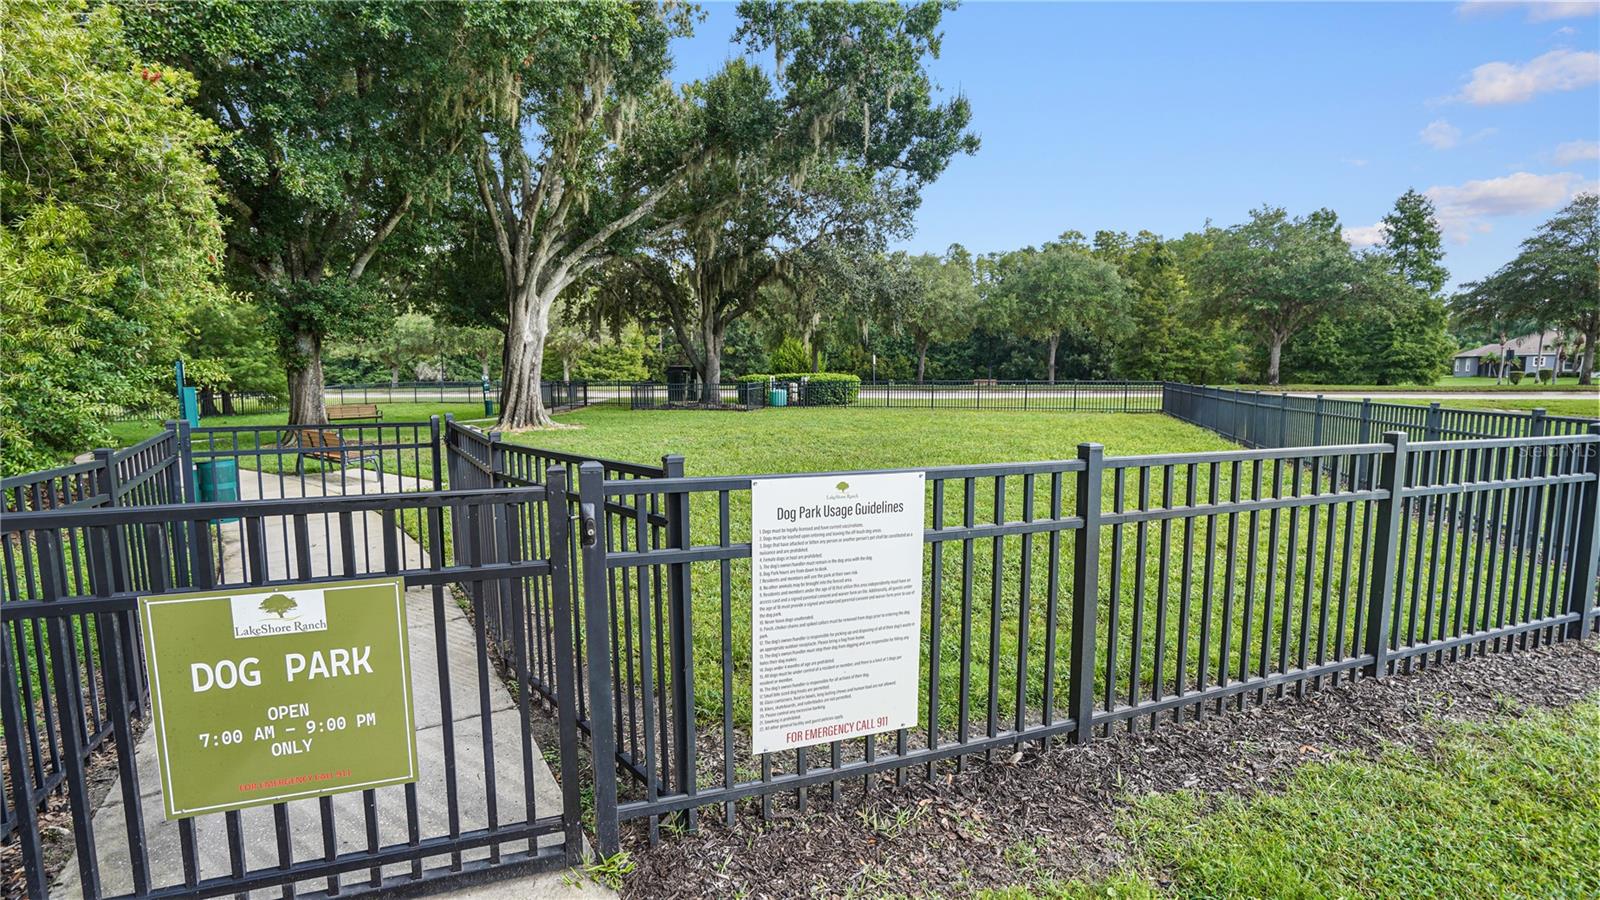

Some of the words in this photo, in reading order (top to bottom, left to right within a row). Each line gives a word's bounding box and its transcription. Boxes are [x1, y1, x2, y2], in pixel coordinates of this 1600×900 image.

[777, 507, 796, 523] Dog
[799, 505, 821, 519] Park
[823, 504, 853, 519] Usage
[855, 501, 904, 515] Guidelines
[235, 623, 292, 637] LakeShore
[294, 619, 327, 632] Ranch
[190, 657, 262, 693] DOG
[285, 645, 374, 682] PARK
[267, 703, 310, 721] OPEN
[199, 730, 244, 748] 7:00
[254, 725, 276, 742] AM
[305, 716, 347, 735] 9:00
[356, 712, 376, 728] PM
[787, 731, 803, 744] FOR
[805, 722, 855, 740] EMERGENCY
[856, 719, 874, 732] CALL
[877, 716, 888, 727] 911
[271, 739, 313, 757] ONLY
